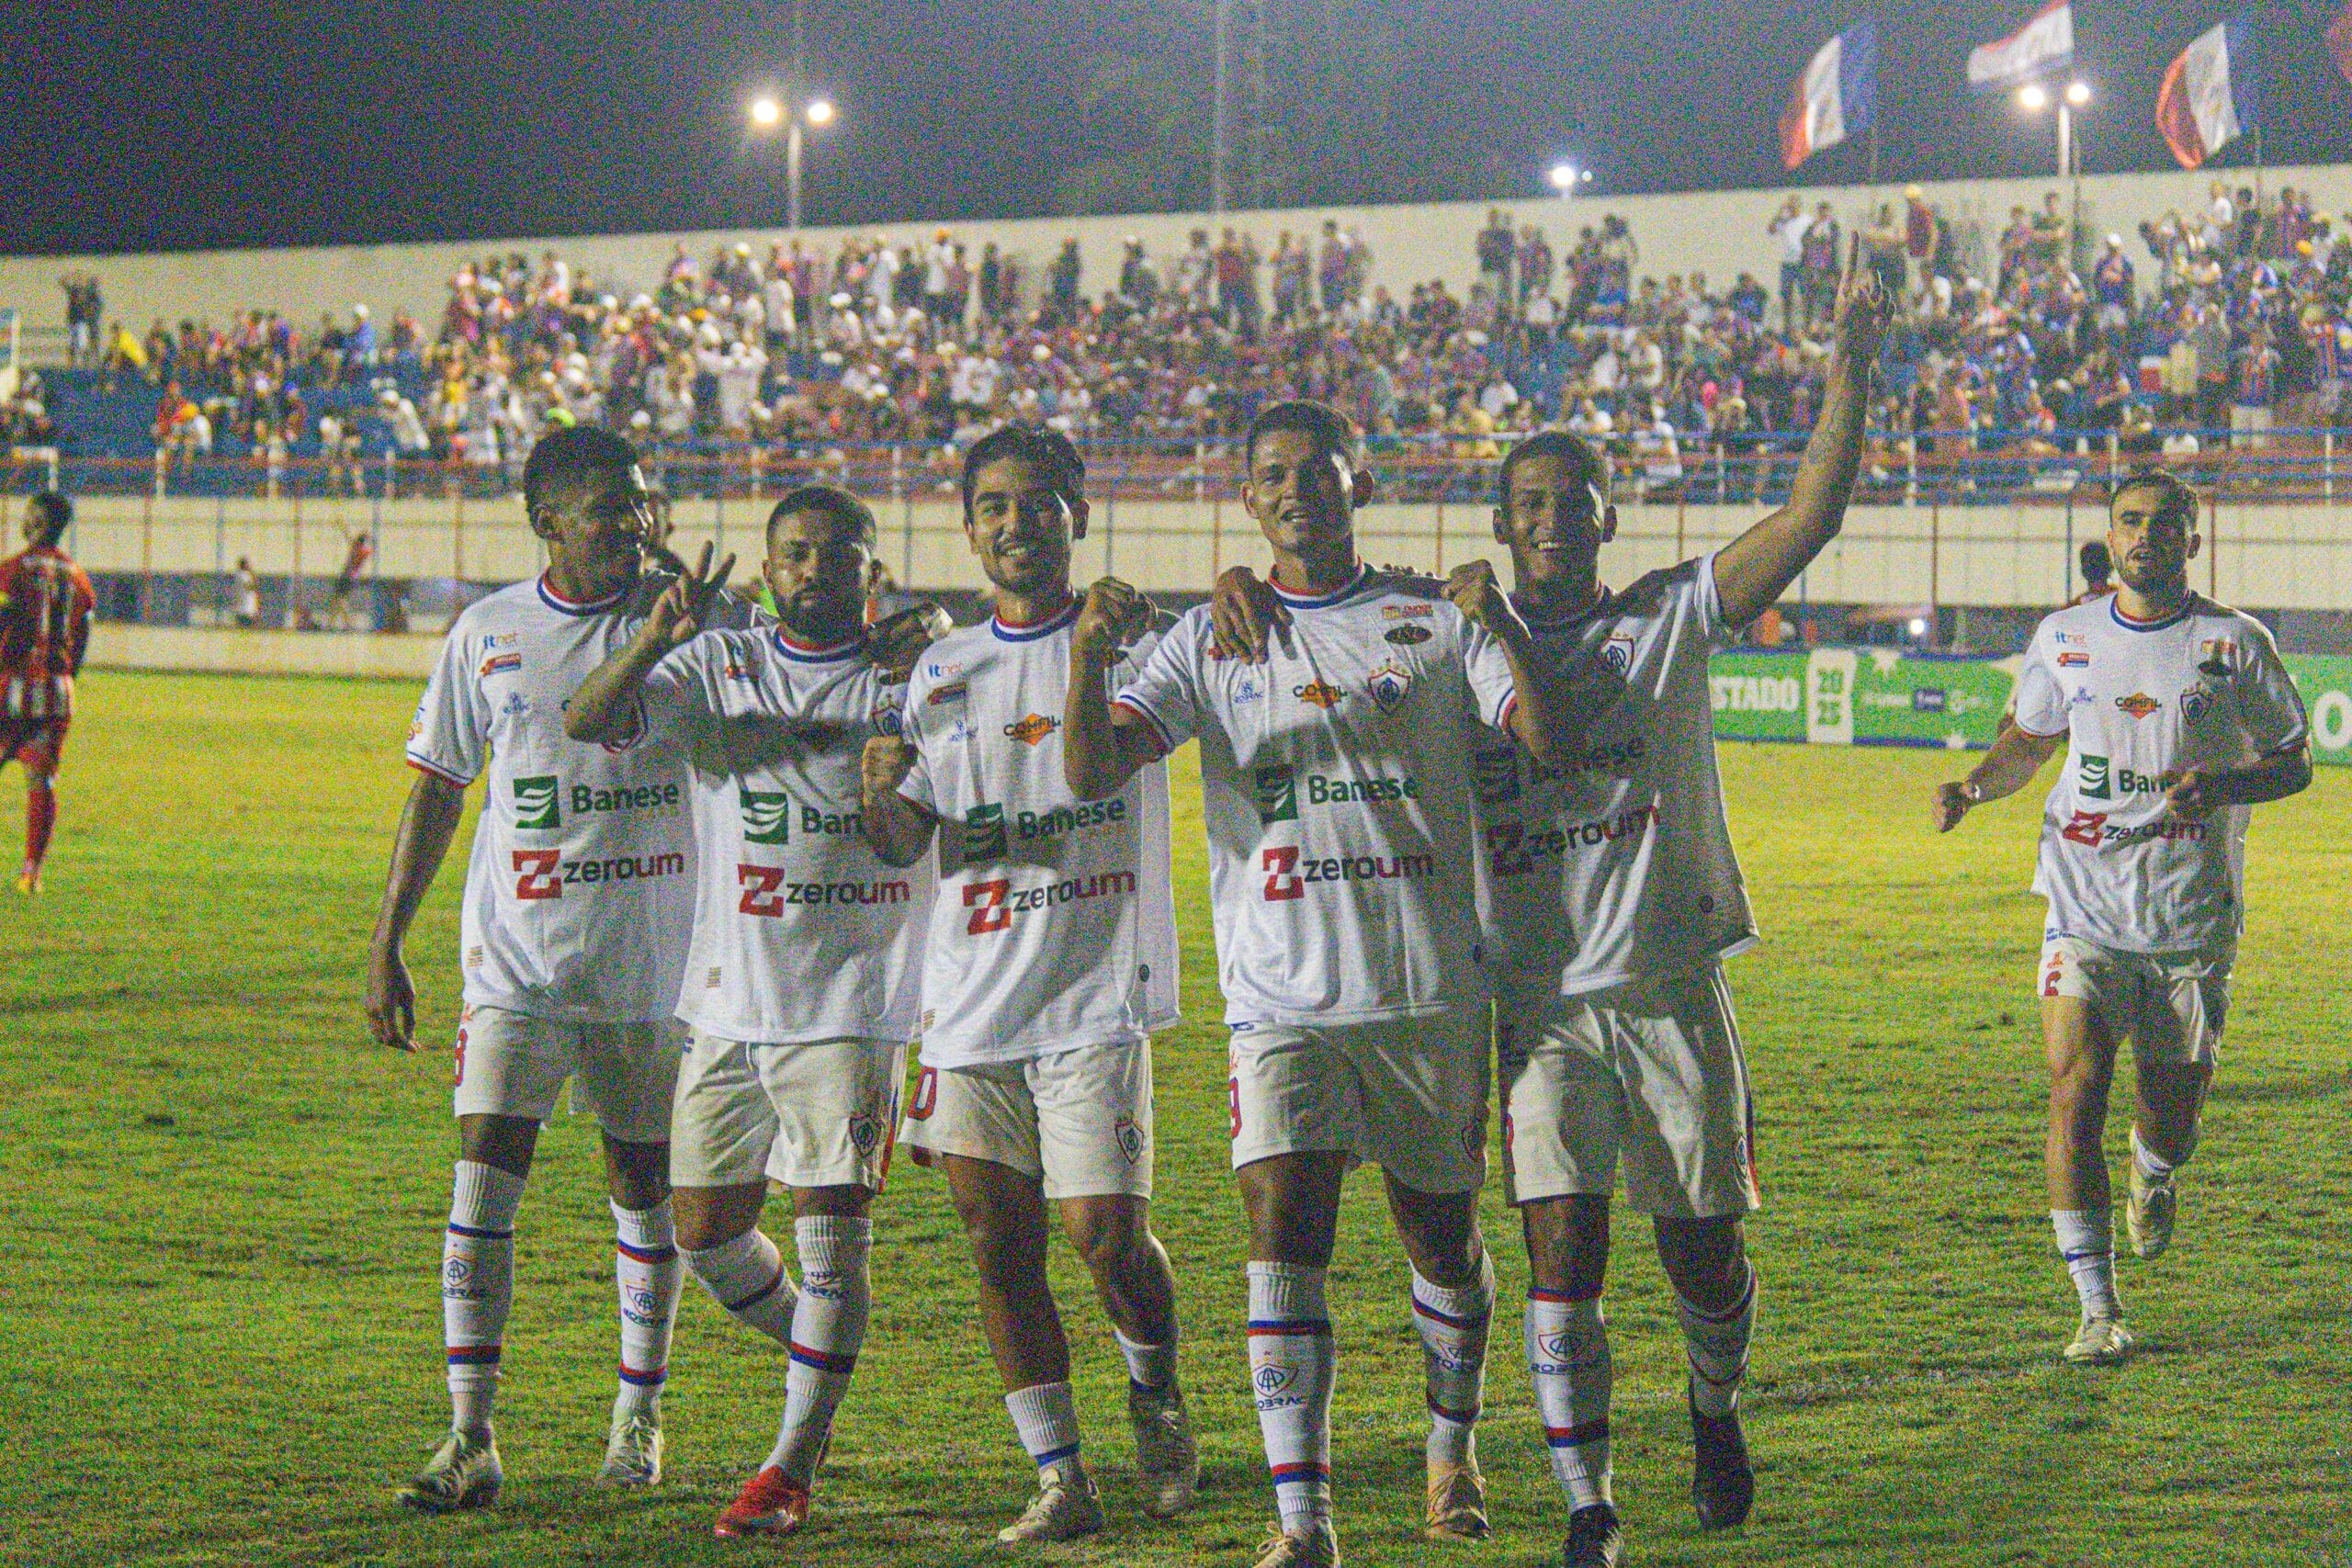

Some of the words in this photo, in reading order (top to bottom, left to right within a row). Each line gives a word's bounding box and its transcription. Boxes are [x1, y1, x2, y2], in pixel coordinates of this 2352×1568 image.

[1709, 676, 1800, 711] STADO
[1307, 774, 1419, 805] Banese
[2119, 769, 2169, 793] Ban
[571, 783, 680, 814] Banese
[801, 806, 864, 834] Ban
[1017, 797, 1126, 840] Banese
[1528, 805, 1661, 857] zeroum
[2105, 820, 2206, 842] zeroum
[562, 852, 684, 884] zeroum
[1302, 853, 1434, 883] zeroum
[786, 880, 910, 905] zeroum
[1012, 870, 1136, 912] zeroum
